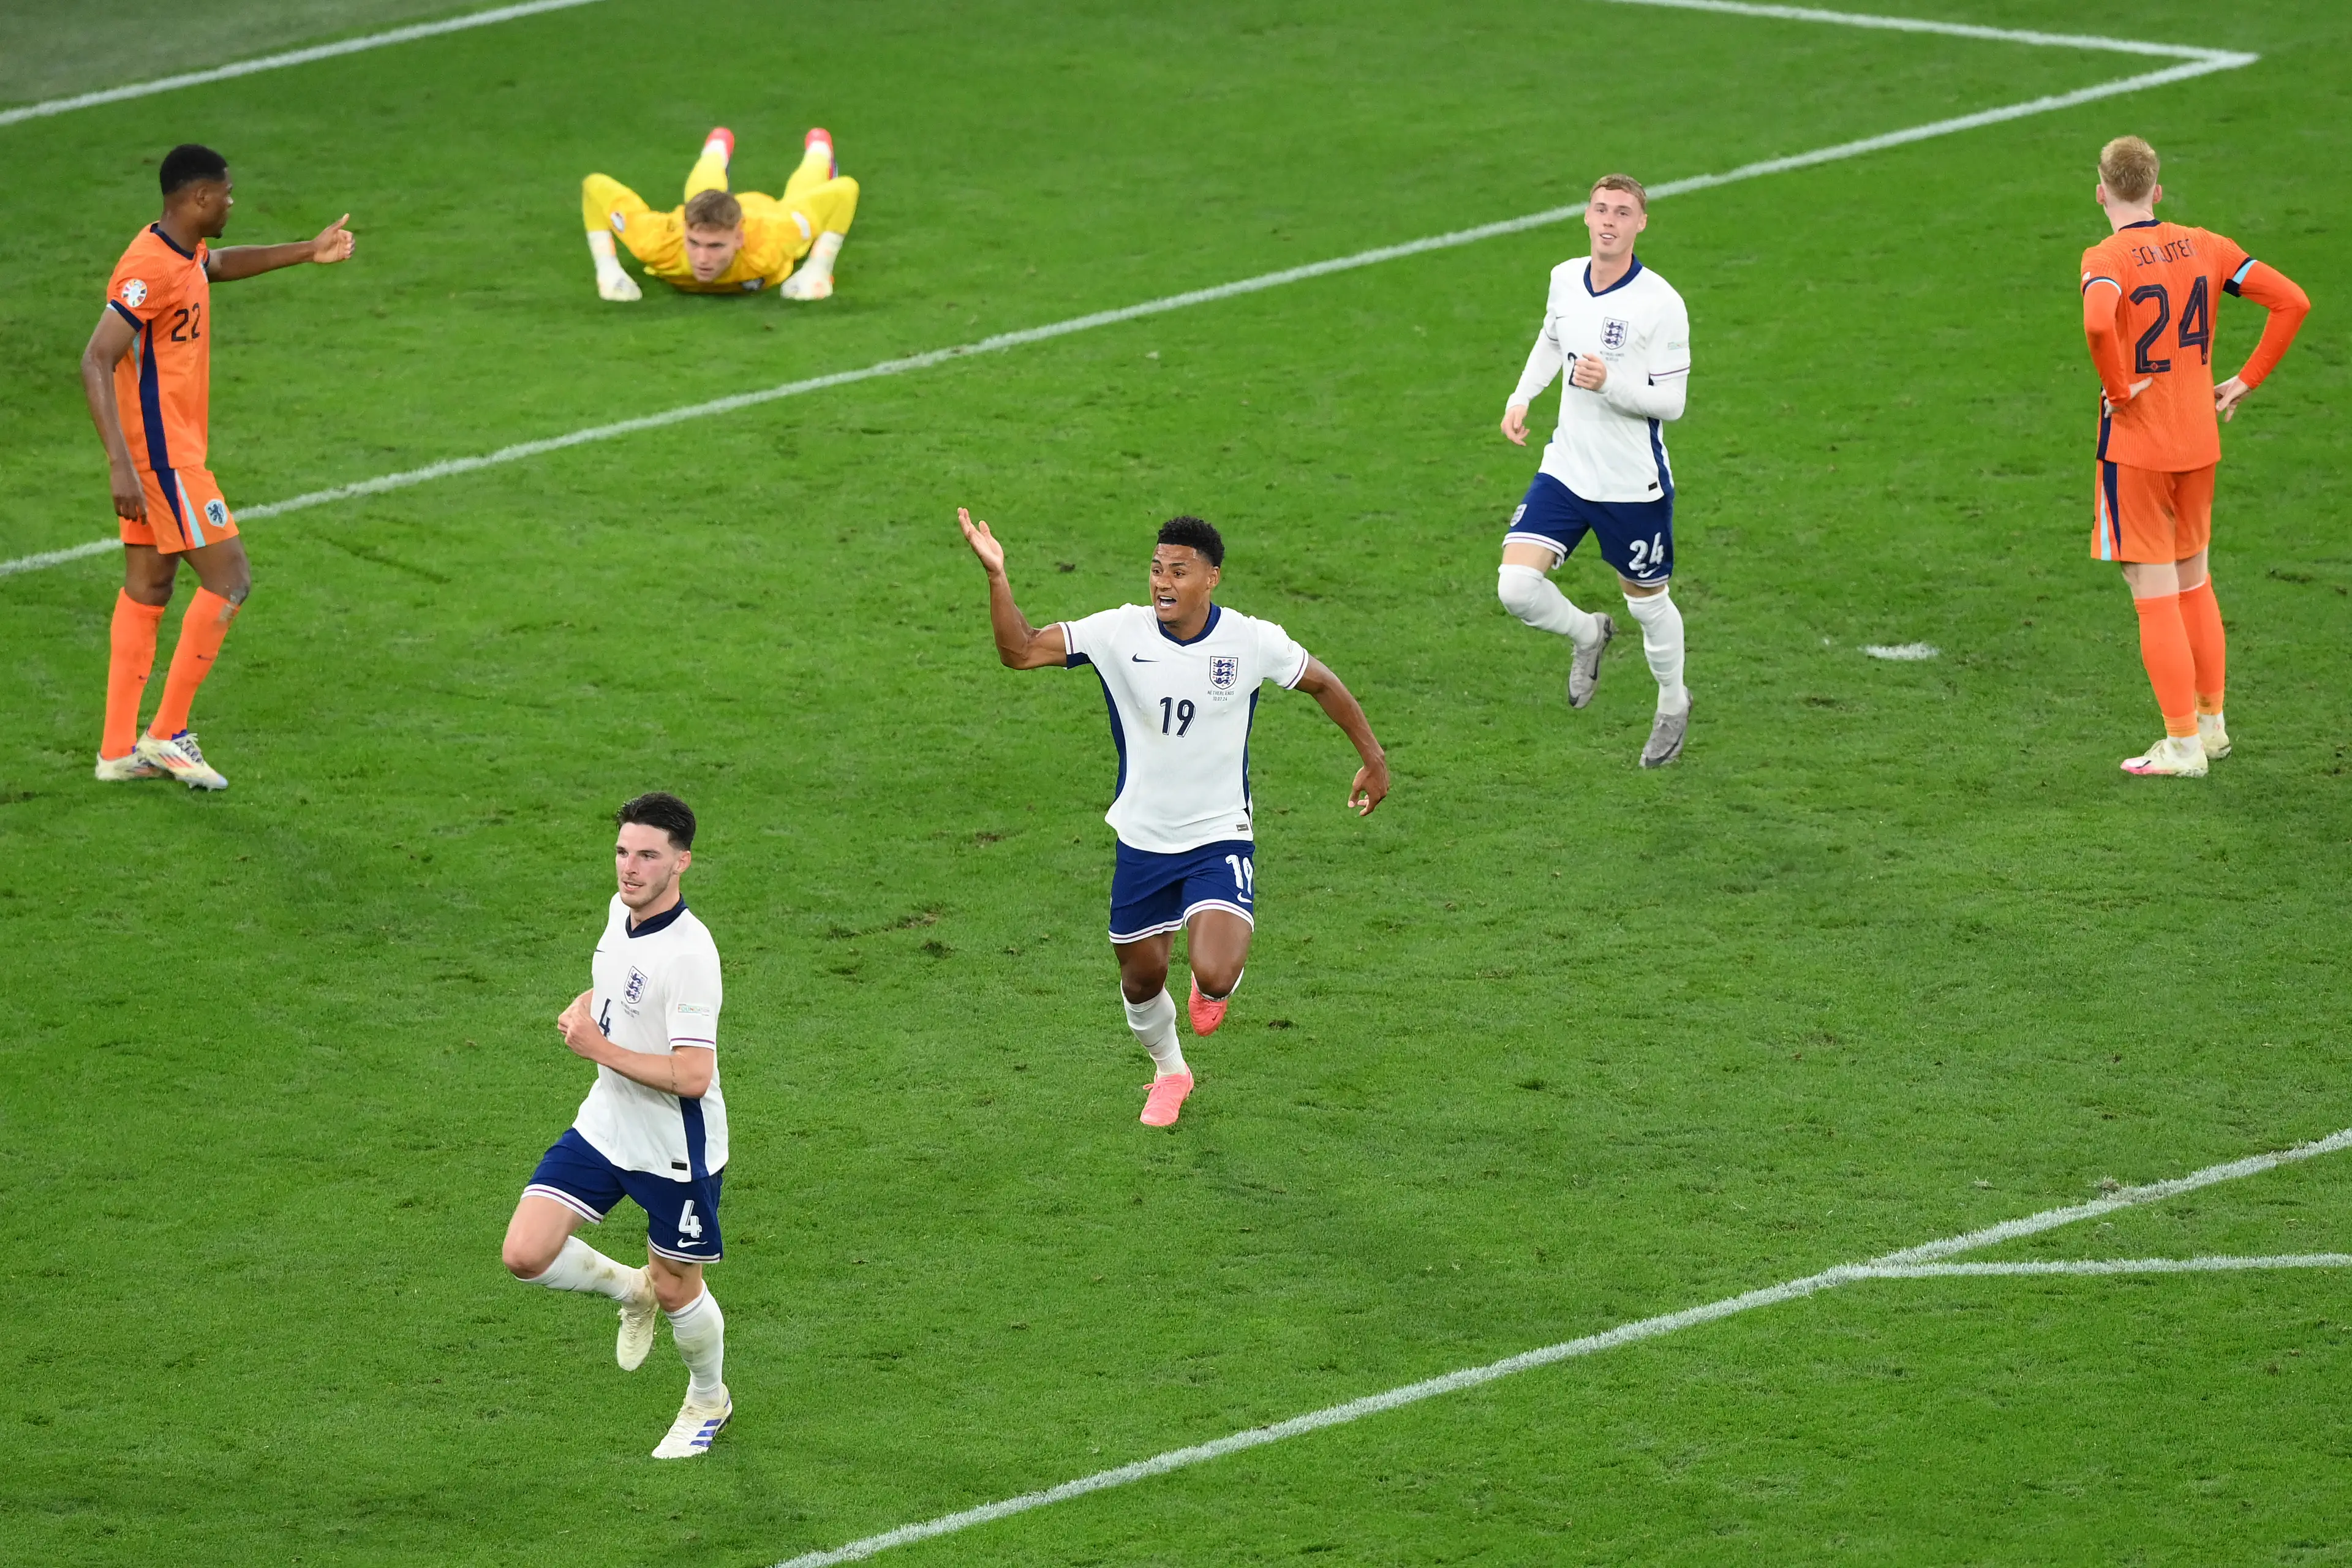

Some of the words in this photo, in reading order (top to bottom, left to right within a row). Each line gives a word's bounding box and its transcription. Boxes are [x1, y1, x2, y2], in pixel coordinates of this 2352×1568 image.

[172, 303, 200, 341] 22
[2129, 276, 2209, 374] 24
[1629, 532, 1664, 570] 24
[1159, 696, 1196, 737] 19
[1226, 854, 1253, 895] 19
[598, 998, 611, 1039] 4
[679, 1199, 702, 1238] 4
